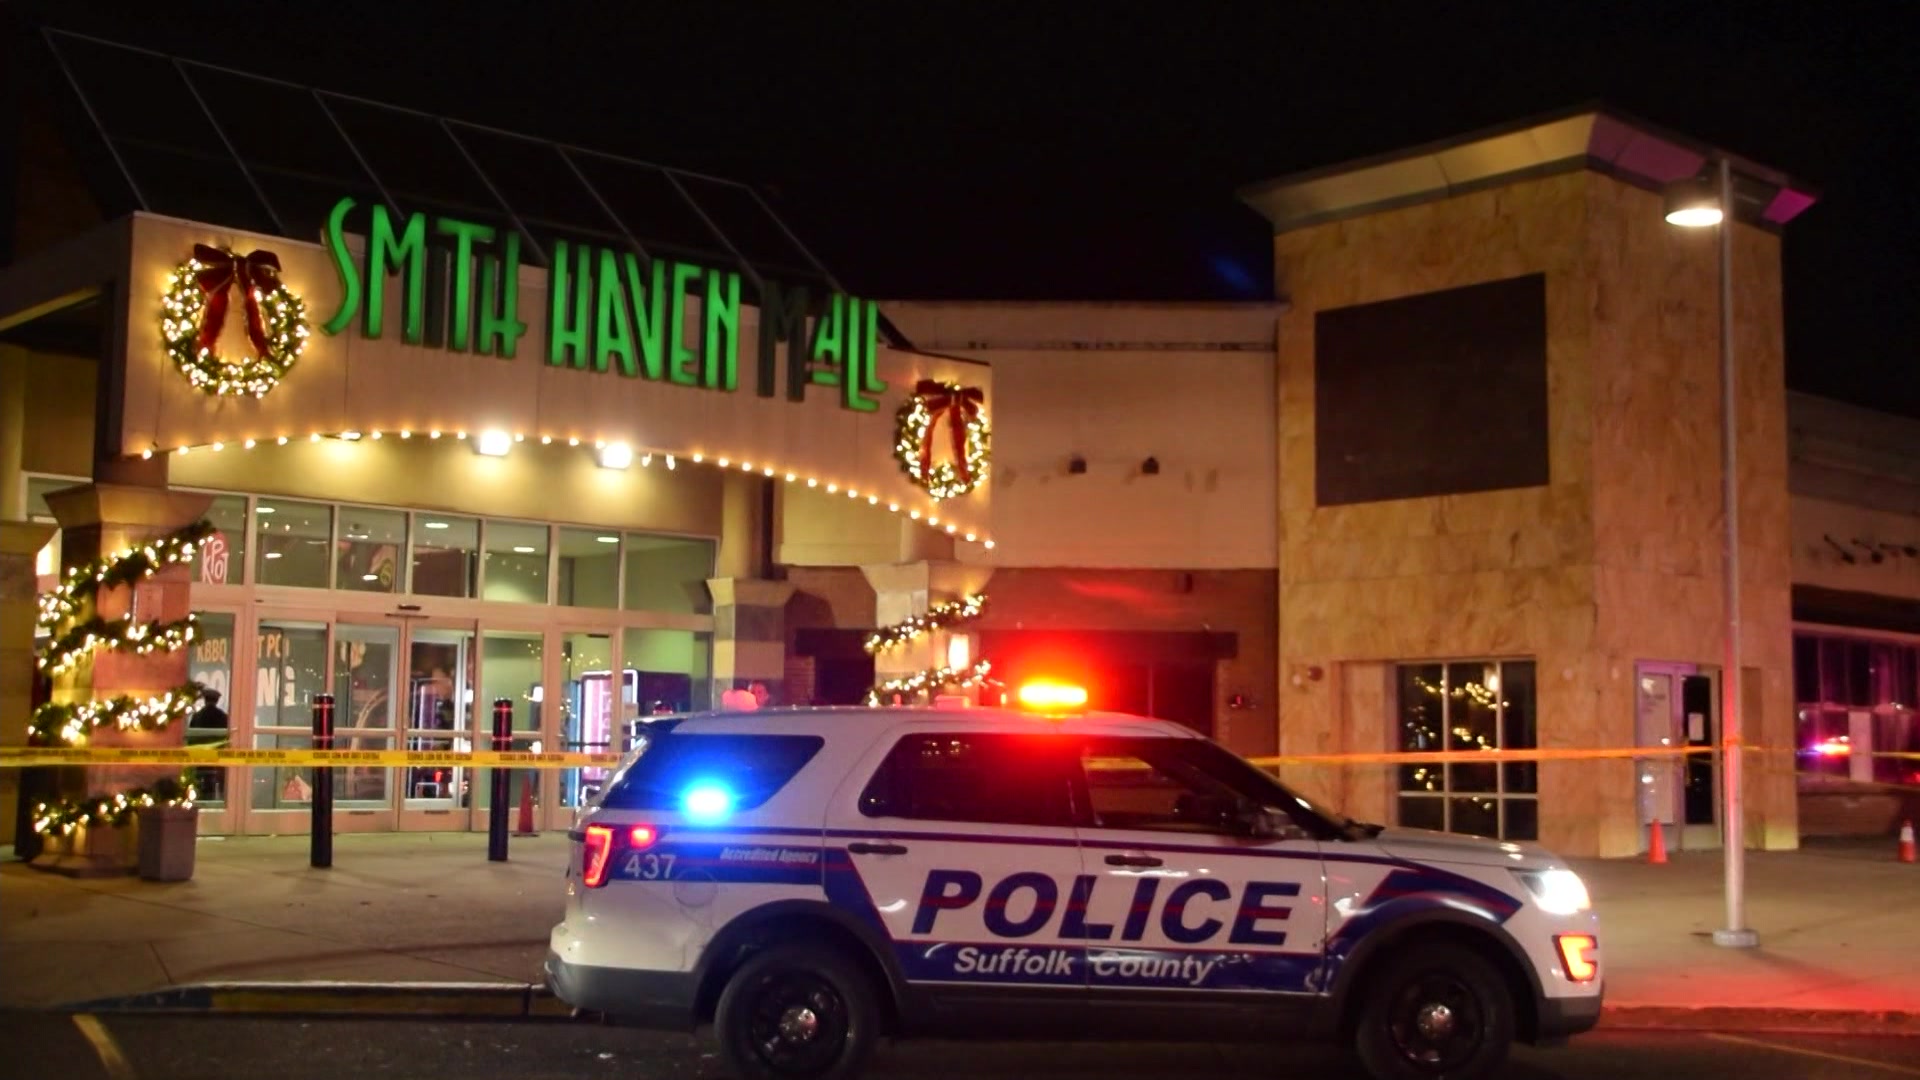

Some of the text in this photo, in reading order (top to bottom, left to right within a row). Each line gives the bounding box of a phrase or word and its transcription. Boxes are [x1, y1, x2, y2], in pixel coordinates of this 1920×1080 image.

[549, 239, 741, 391] HAVEN
[758, 280, 888, 412] MALL
[624, 854, 676, 878] 437
[719, 846, 818, 865] Accredited Agency
[911, 868, 1301, 946] POLICE
[953, 947, 1215, 986] Suffolk County
